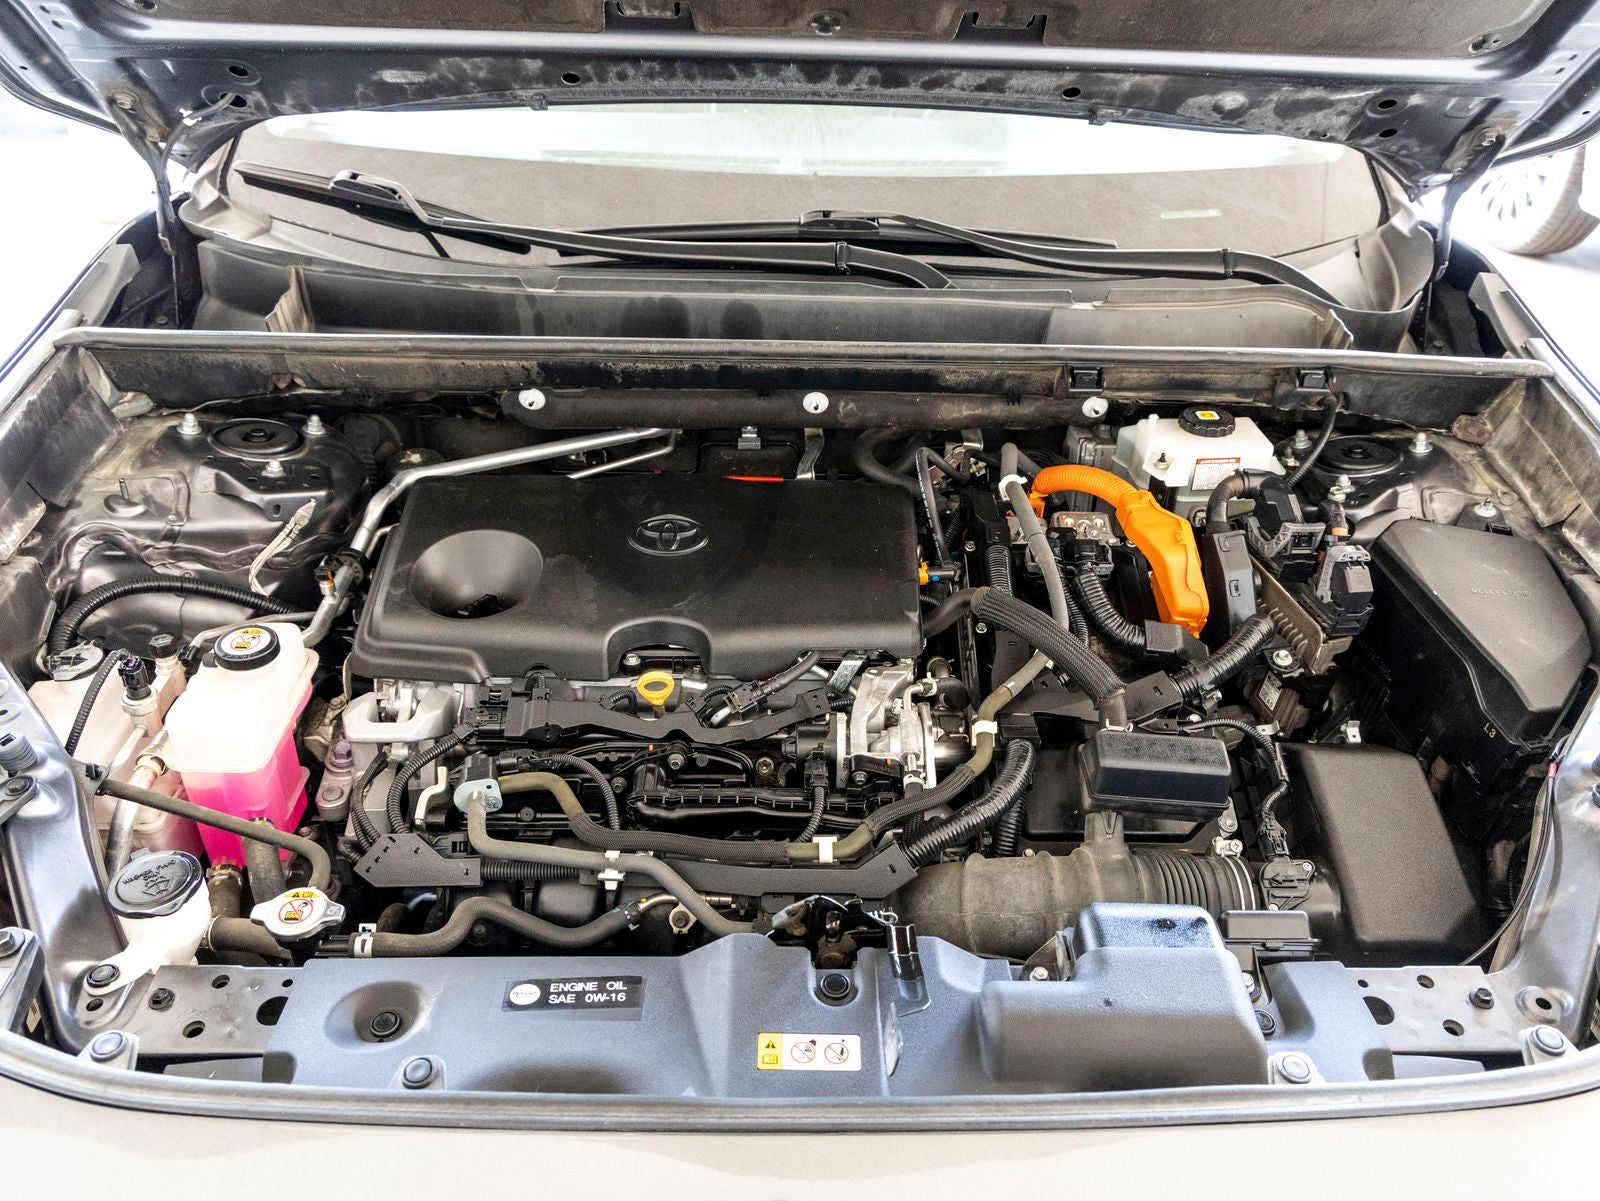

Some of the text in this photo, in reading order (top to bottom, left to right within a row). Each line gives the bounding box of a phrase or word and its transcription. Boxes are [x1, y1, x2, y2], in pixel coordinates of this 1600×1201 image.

[550, 981, 628, 993] ENGINE OIL
[548, 994, 576, 1004] SAE
[584, 992, 626, 1003] 0W-16
